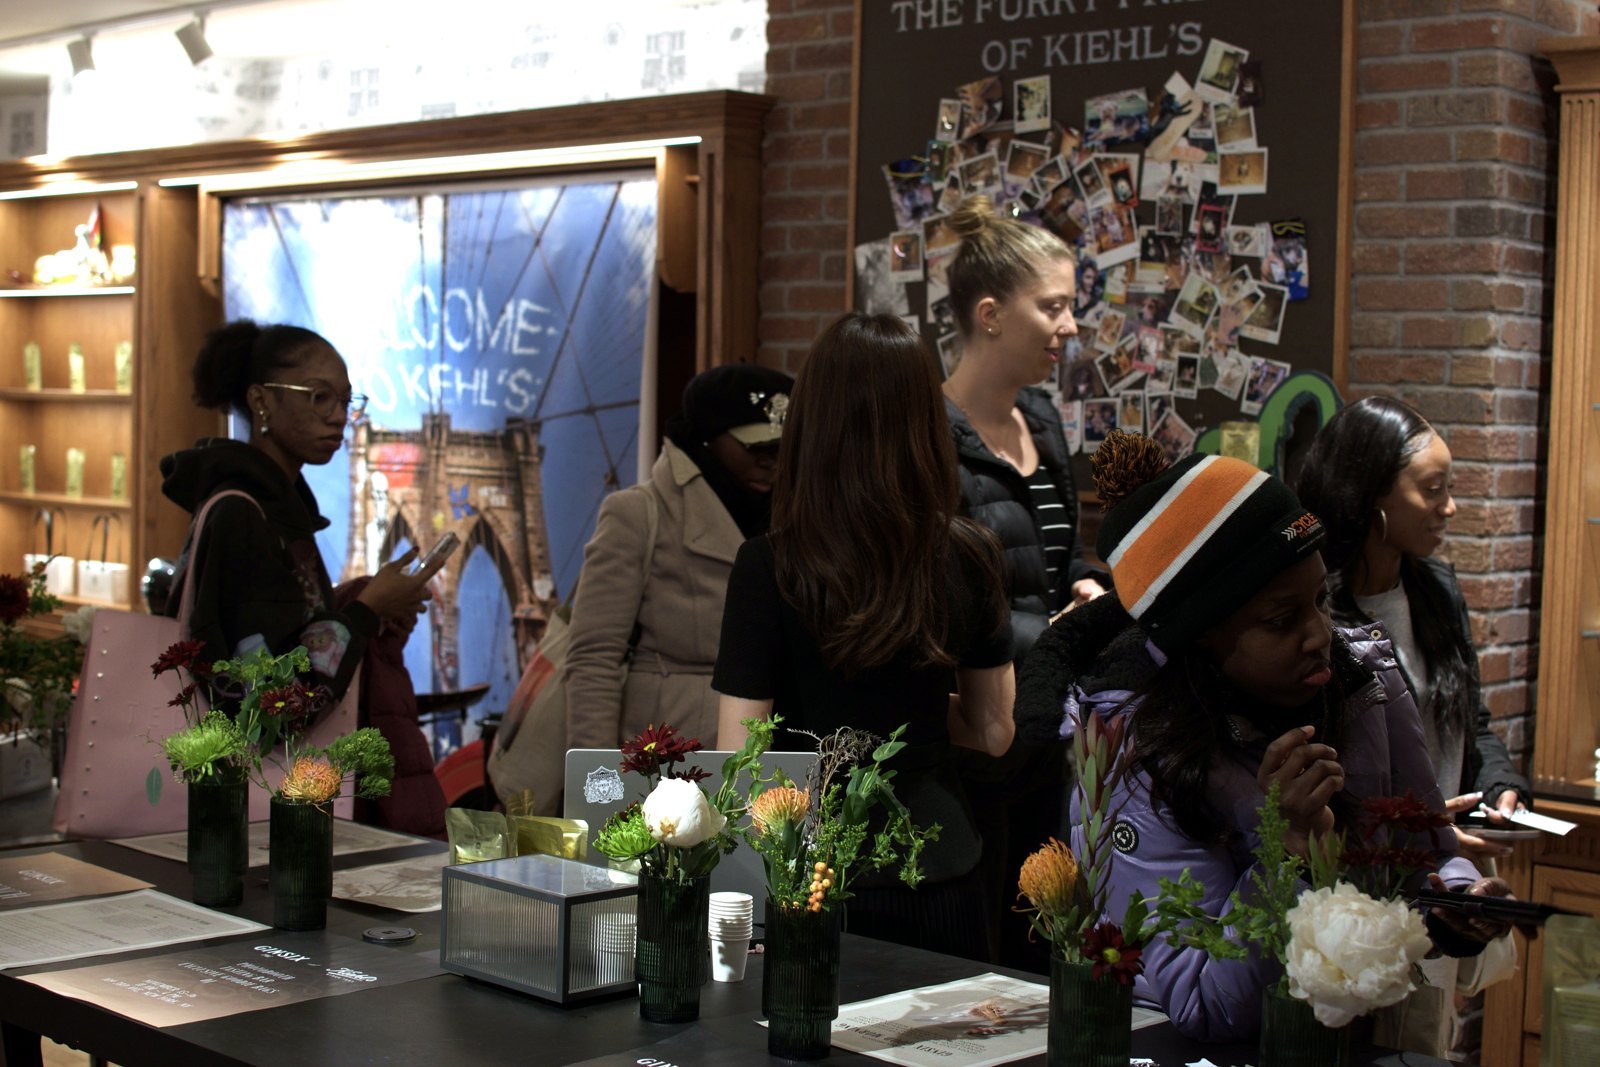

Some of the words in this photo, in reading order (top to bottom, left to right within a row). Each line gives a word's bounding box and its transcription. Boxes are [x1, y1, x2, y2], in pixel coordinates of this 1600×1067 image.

[892, 0, 964, 32] THE
[981, 39, 1033, 72] OF
[1043, 21, 1203, 68] KIEHL'S
[382, 283, 551, 356] LCOME
[254, 945, 311, 963] GINSIX
